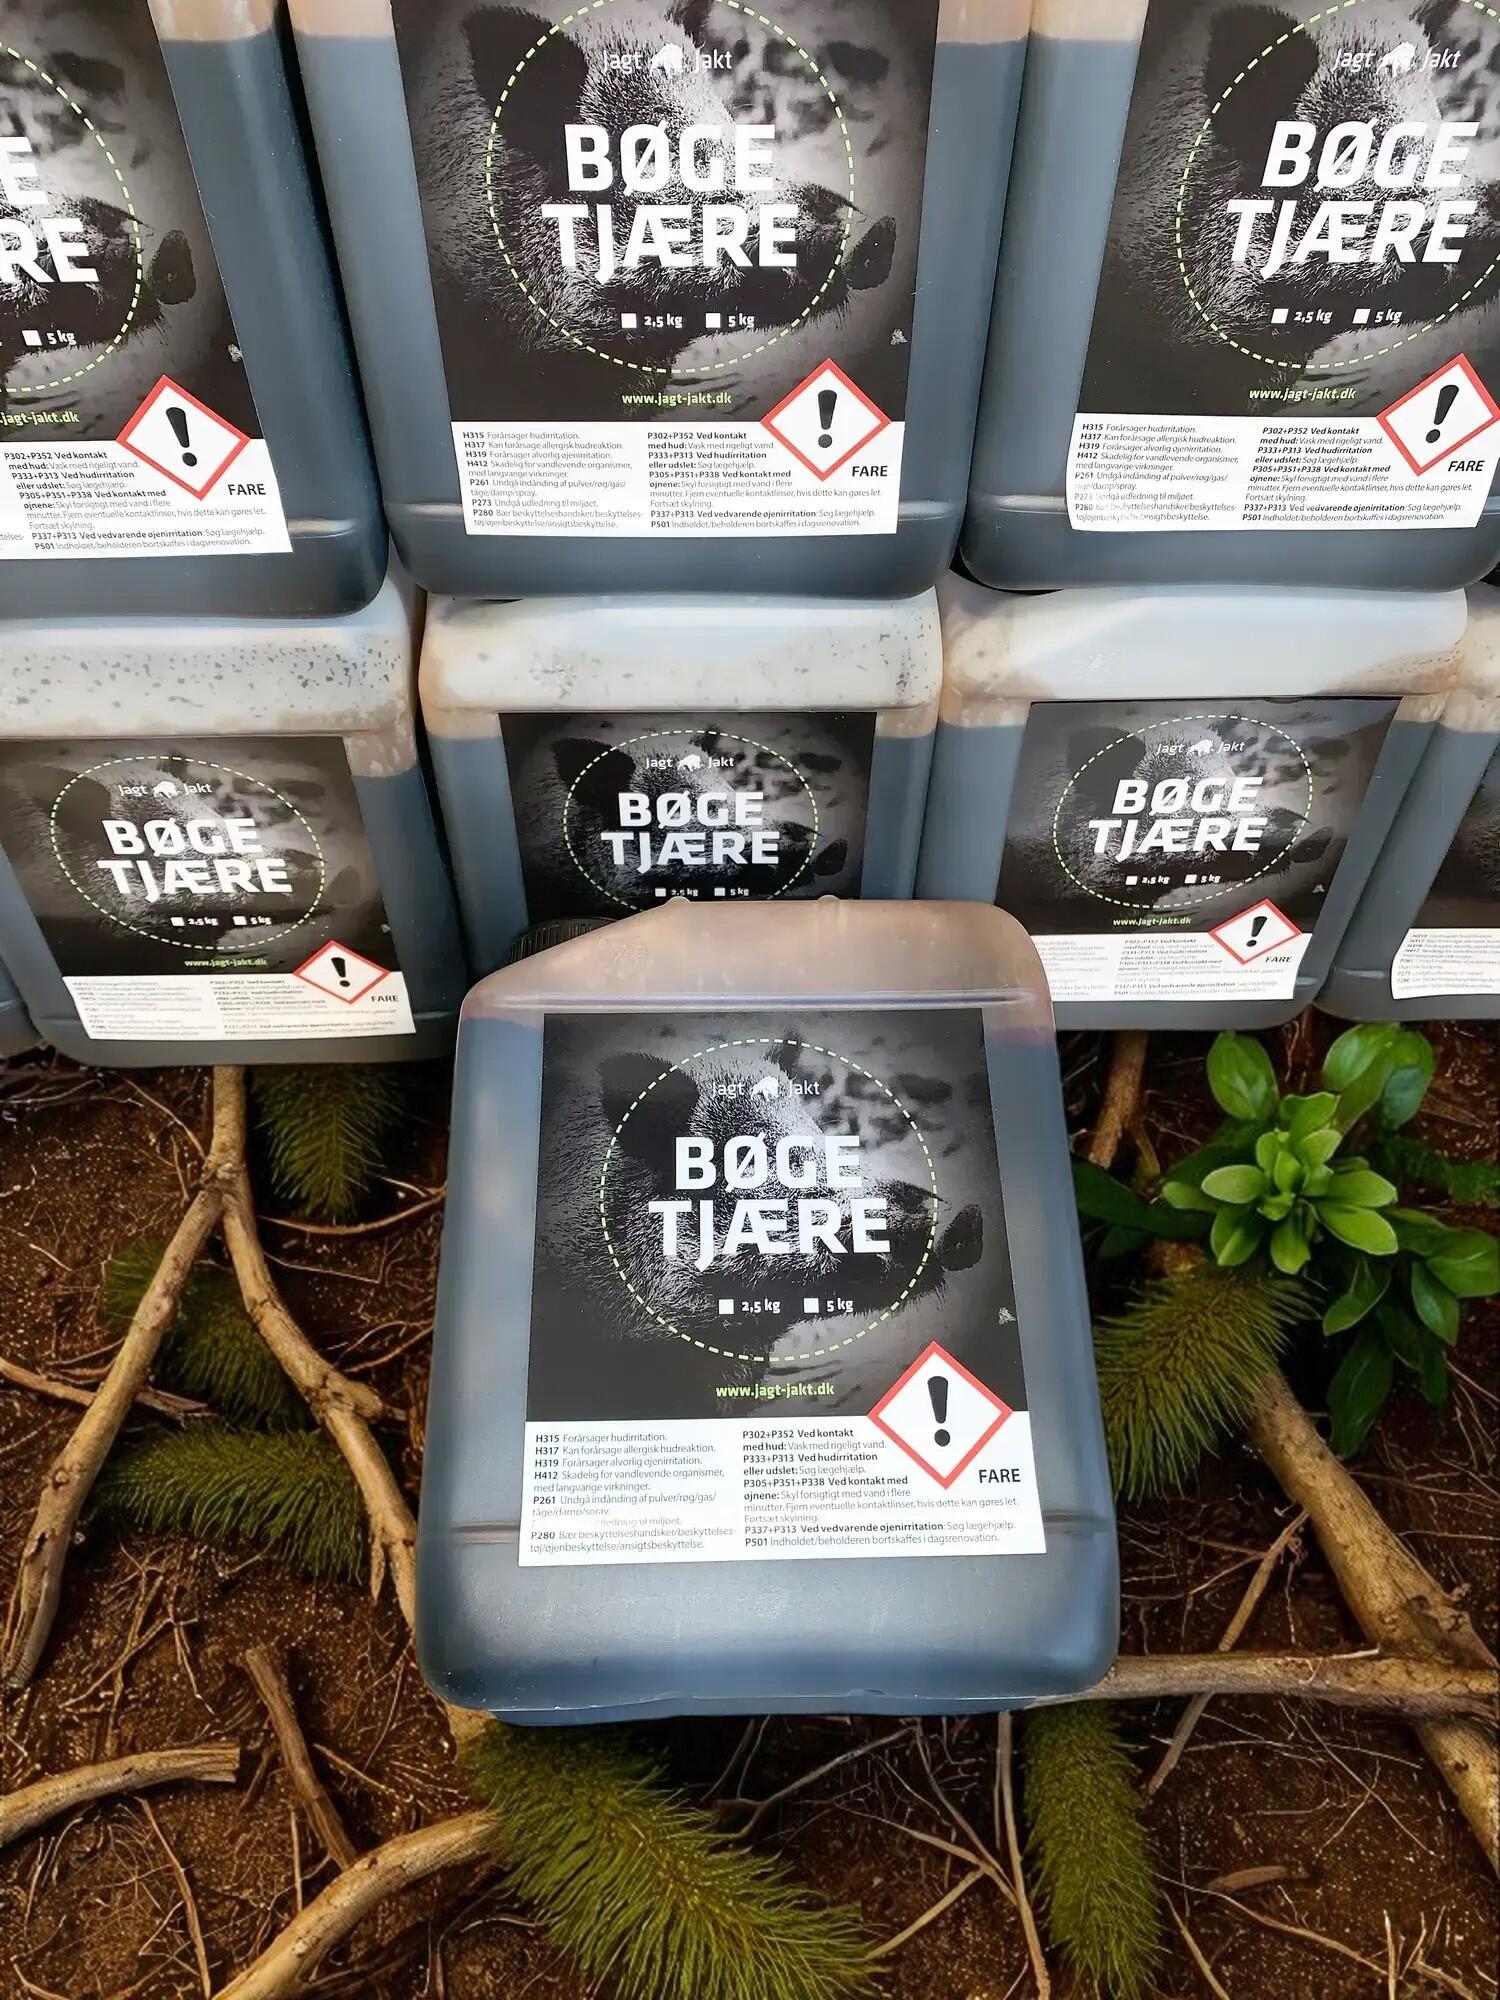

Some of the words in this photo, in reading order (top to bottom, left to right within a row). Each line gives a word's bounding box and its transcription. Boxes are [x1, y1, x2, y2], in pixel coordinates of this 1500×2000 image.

[564, 120, 775, 196] BØGE
[1261, 118, 1480, 192] BØGE
[541, 204, 798, 284] TJÆRE
[1227, 200, 1478, 280] TJÆRE
[644, 315, 663, 327] 2,5
[666, 314, 682, 328] kg
[729, 315, 736, 326] 5
[739, 314, 754, 328] kg
[1294, 311, 1314, 323] 2,5
[1316, 310, 1332, 324] kg
[1375, 312, 1383, 322] 5
[1385, 310, 1402, 322] kg
[47, 333, 56, 344] 5
[57, 331, 76, 345] kg
[621, 392, 732, 406] www.jagt-jakt.dk
[1249, 386, 1356, 400] www.jagt-jakt.dk
[0, 411, 80, 425] .jagt-jakt.dk
[4, 452, 51, 460] P302+P352
[852, 466, 887, 477] FARE
[1448, 460, 1485, 473] FARE
[12, 472, 58, 480] P333+P313
[80, 471, 134, 479] hudirritation
[228, 484, 266, 495] FARE
[1112, 776, 1262, 816] BØGE
[618, 791, 763, 829] BØGE
[102, 818, 262, 856] BØGE
[1089, 818, 1267, 862] TJÆRE
[601, 832, 779, 874] TJÆRE
[97, 859, 293, 903] TJÆRE
[1158, 876, 1170, 884] kg
[1209, 874, 1220, 884] kg
[687, 888, 698, 897] kg
[737, 887, 749, 896] kg
[205, 917, 217, 926] kg
[259, 916, 271, 925] kg
[371, 994, 399, 1002] FARE
[675, 1132, 862, 1193] BØGE
[649, 1198, 890, 1272] TJÆRE
[741, 1300, 762, 1313] 2,5
[765, 1299, 781, 1313] kg
[827, 1300, 834, 1311] 5
[838, 1298, 854, 1312] kg
[716, 1383, 834, 1399] www.jagt-jakt.dk
[536, 1435, 559, 1443] H315
[563, 1434, 609, 1444] Forårsager
[743, 1430, 793, 1439] P302+P352
[798, 1429, 815, 1438] Ved
[817, 1429, 853, 1437] kontakt
[535, 1447, 559, 1455] H317
[563, 1446, 580, 1455] Kan
[581, 1446, 621, 1457] forårsage
[623, 1445, 659, 1456] allergisk
[660, 1444, 716, 1454] hudreaktion.
[743, 1443, 763, 1451] med
[766, 1442, 787, 1450] hud:
[788, 1442, 808, 1450] Vask
[810, 1441, 829, 1449] med
[831, 1441, 861, 1451] rigeligt
[862, 1440, 886, 1448] vand.
[535, 1459, 559, 1467] H319
[562, 1458, 609, 1468] Forårsager
[610, 1457, 642, 1467] alvorlig
[743, 1454, 794, 1463] P333+P313
[798, 1454, 816, 1462] Ved
[818, 1453, 878, 1461] hudirritation
[534, 1471, 558, 1480] H412
[561, 1471, 599, 1481] Skadelig
[601, 1470, 613, 1478] for
[614, 1469, 671, 1478] vandlevende
[673, 1468, 725, 1479] organismer,
[744, 1467, 764, 1475] eller
[766, 1466, 798, 1475] udslet:
[799, 1466, 817, 1476] Søg
[979, 1469, 1021, 1483] FARE
[534, 1484, 555, 1493] med
[556, 1483, 602, 1494] langvarige
[604, 1482, 650, 1492] virkninger.
[744, 1478, 825, 1487] P305+P351+P338
[828, 1478, 846, 1486] Ved
[848, 1477, 885, 1485] kontakt
[887, 1476, 908, 1484] med
[534, 1496, 556, 1505] P261
[639, 1493, 648, 1503] af
[744, 1492, 780, 1502] øjnene:
[781, 1490, 798, 1500] Skyl
[801, 1489, 840, 1500] forsigtigt
[841, 1489, 861, 1498] med
[864, 1489, 886, 1498] vand
[892, 1489, 911, 1497] flere
[744, 1504, 785, 1512] minutter.
[786, 1502, 808, 1512] Fjern
[810, 1502, 856, 1511] eventuelle
[857, 1500, 916, 1510] kontaktlinser,
[917, 1500, 935, 1508] hvis
[936, 1500, 961, 1508] dette
[962, 1499, 977, 1507] kan
[745, 1525, 796, 1534] P337+P313
[801, 1524, 819, 1533] Ved
[821, 1523, 878, 1532] vedvarende
[531, 1531, 556, 1540] P280
[745, 1538, 768, 1546] P501
[873, 1535, 922, 1544] bortskaffes
